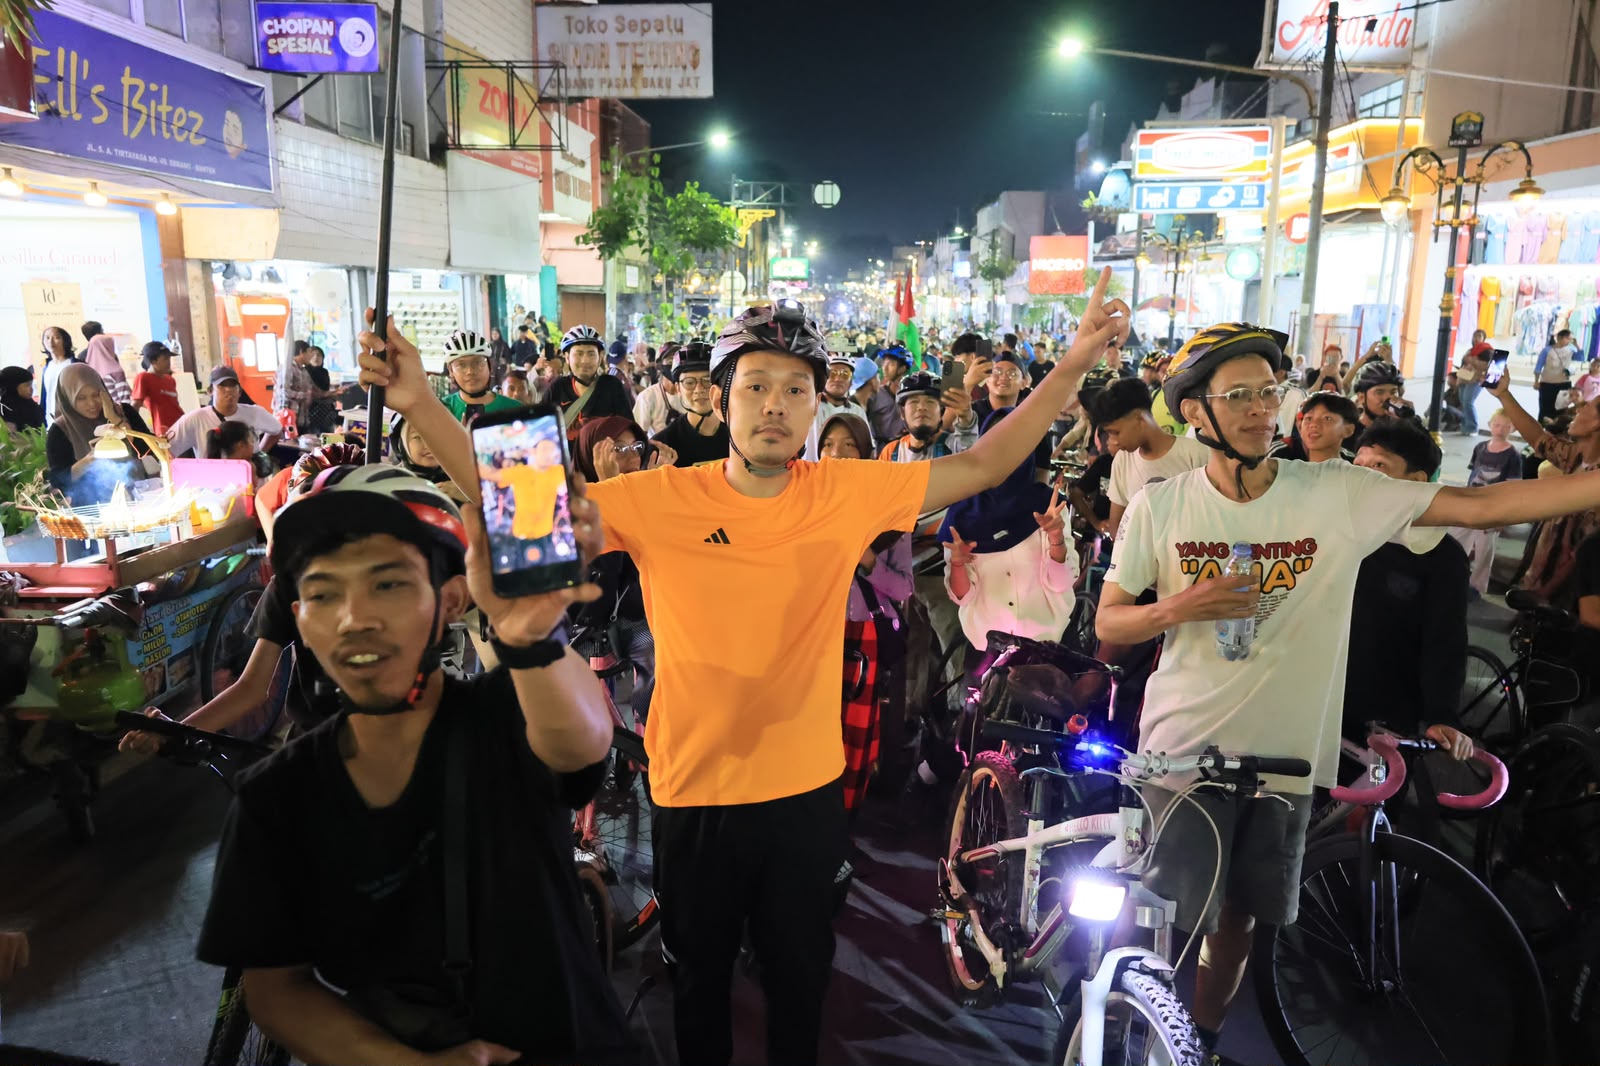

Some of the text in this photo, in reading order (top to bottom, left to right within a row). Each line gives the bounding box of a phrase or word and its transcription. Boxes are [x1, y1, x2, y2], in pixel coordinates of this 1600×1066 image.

[263, 18, 334, 36] CHOIPAN
[564, 15, 684, 36] Toko Sepatu
[267, 37, 333, 55] SPESIAL
[678, 76, 700, 89] JKT
[121, 65, 207, 146] Bitez
[1175, 540, 1230, 559] YANG
